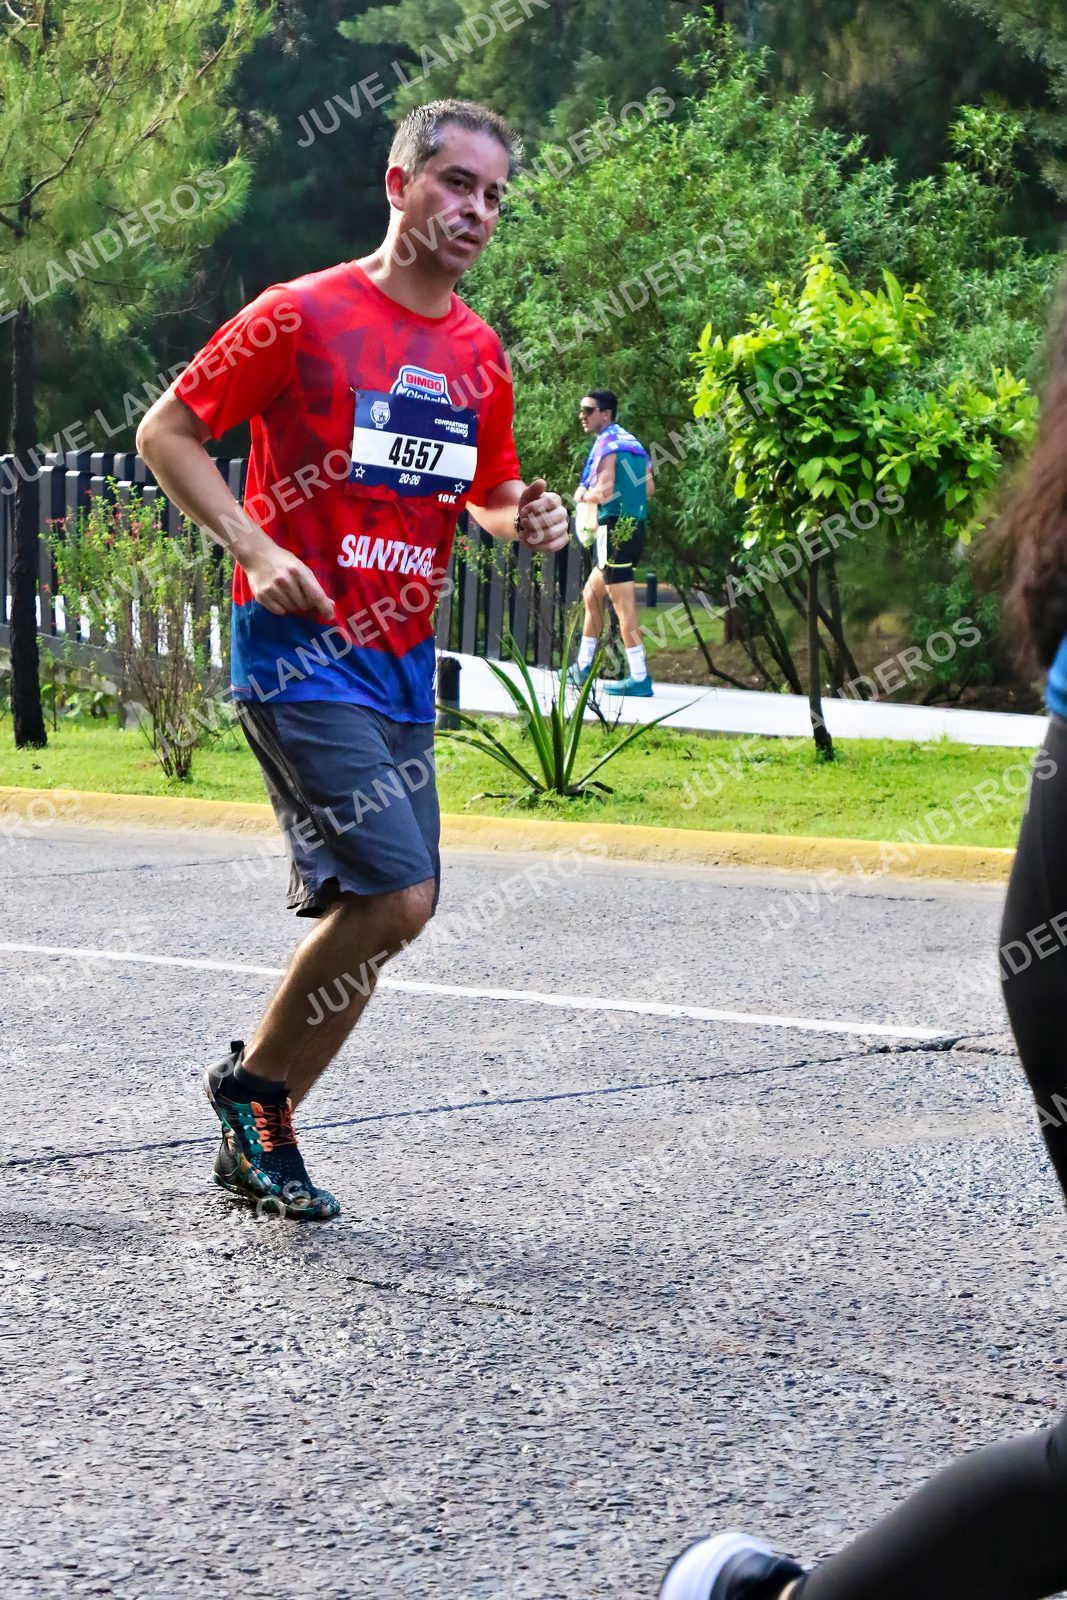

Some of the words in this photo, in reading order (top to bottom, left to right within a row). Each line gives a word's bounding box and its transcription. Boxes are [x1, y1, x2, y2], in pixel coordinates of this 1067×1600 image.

[405, 373, 442, 391] BIMBO
[388, 436, 444, 471] 4557
[437, 493, 457, 504] 10K
